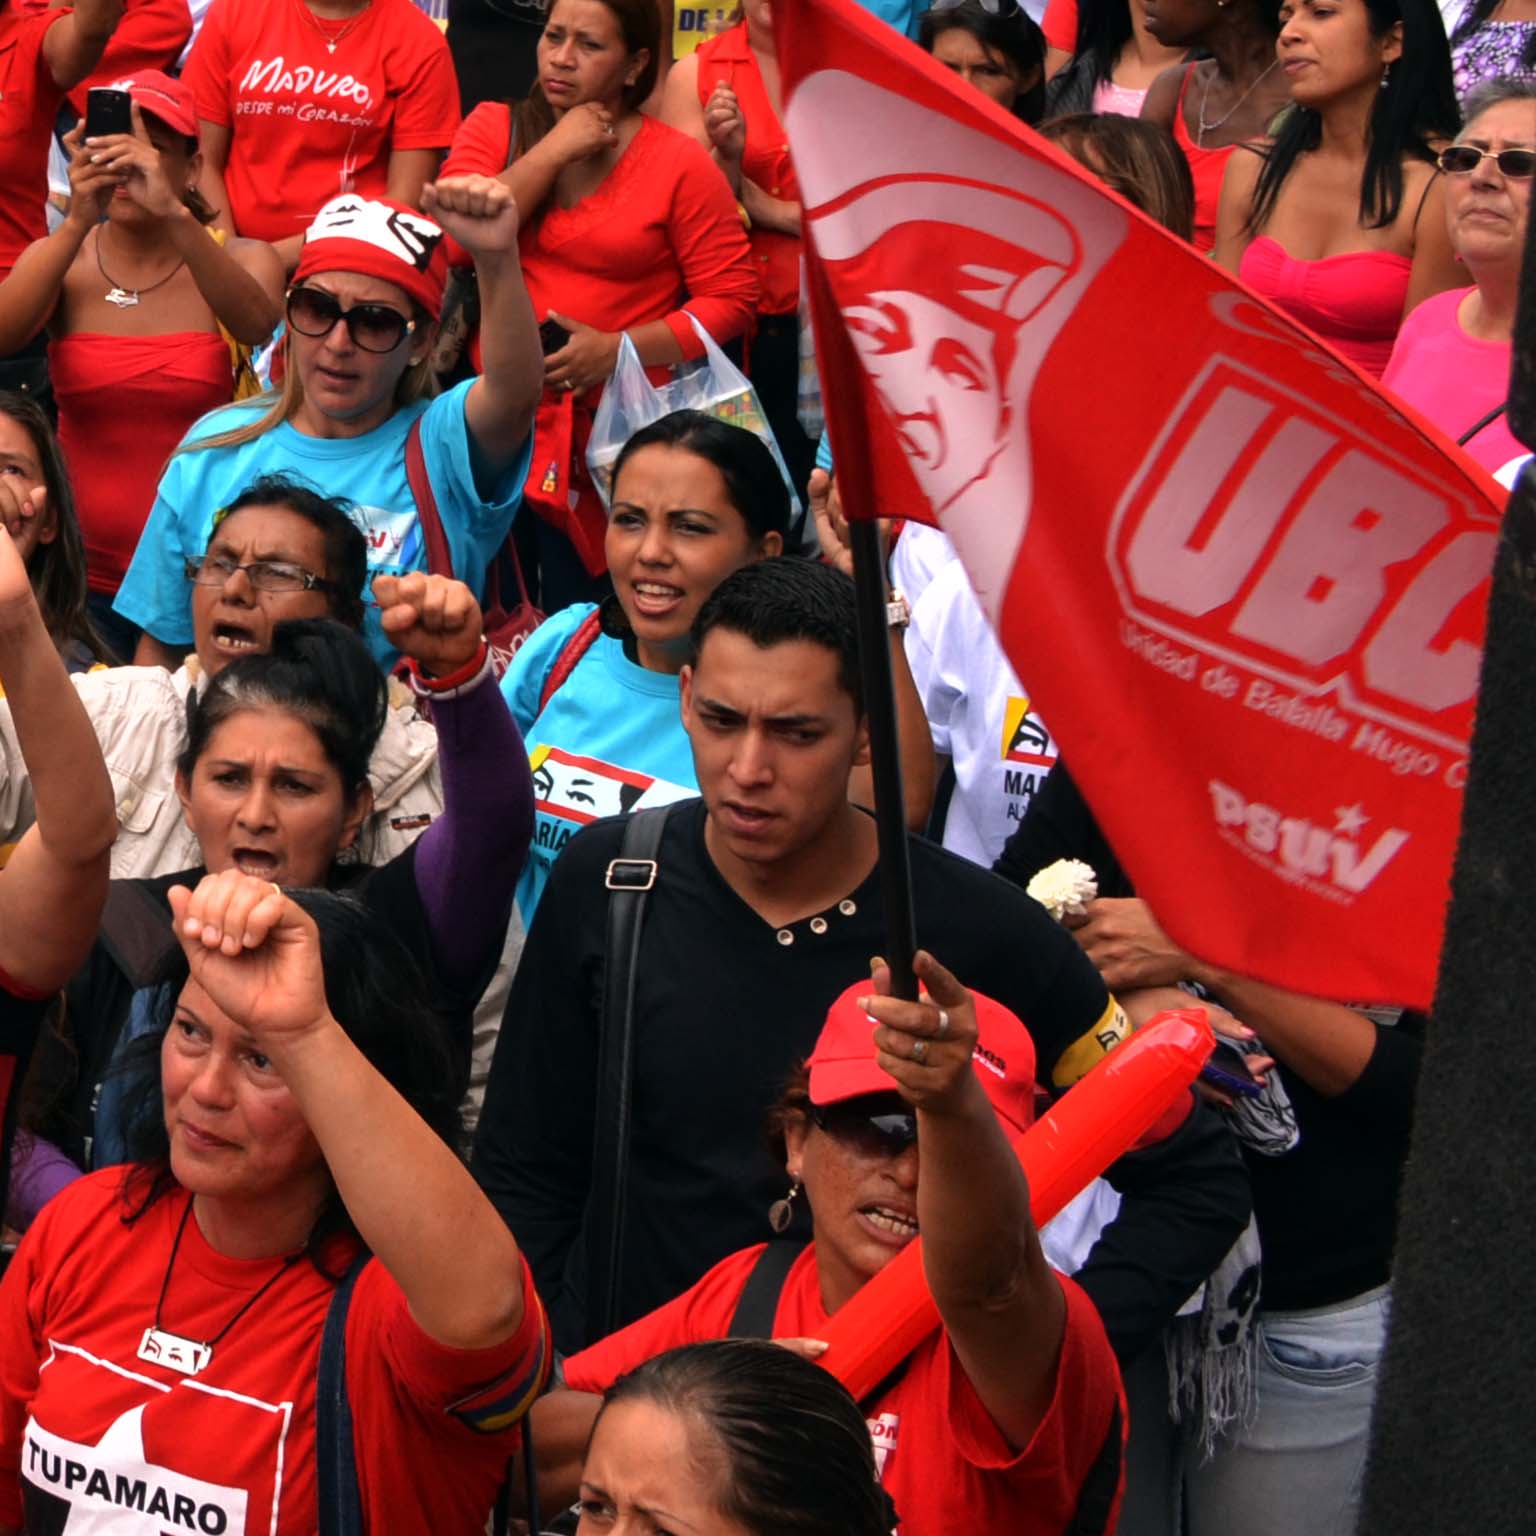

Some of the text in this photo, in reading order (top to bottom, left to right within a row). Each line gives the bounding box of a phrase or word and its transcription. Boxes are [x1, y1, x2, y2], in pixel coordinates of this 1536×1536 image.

[236, 101, 274, 116] DESDE
[1119, 620, 1196, 684] Unidad
[1201, 666, 1238, 699] de
[1248, 676, 1346, 746] Batalla
[1350, 728, 1432, 776] Hugo
[28, 1437, 228, 1535] TUPAMARO
